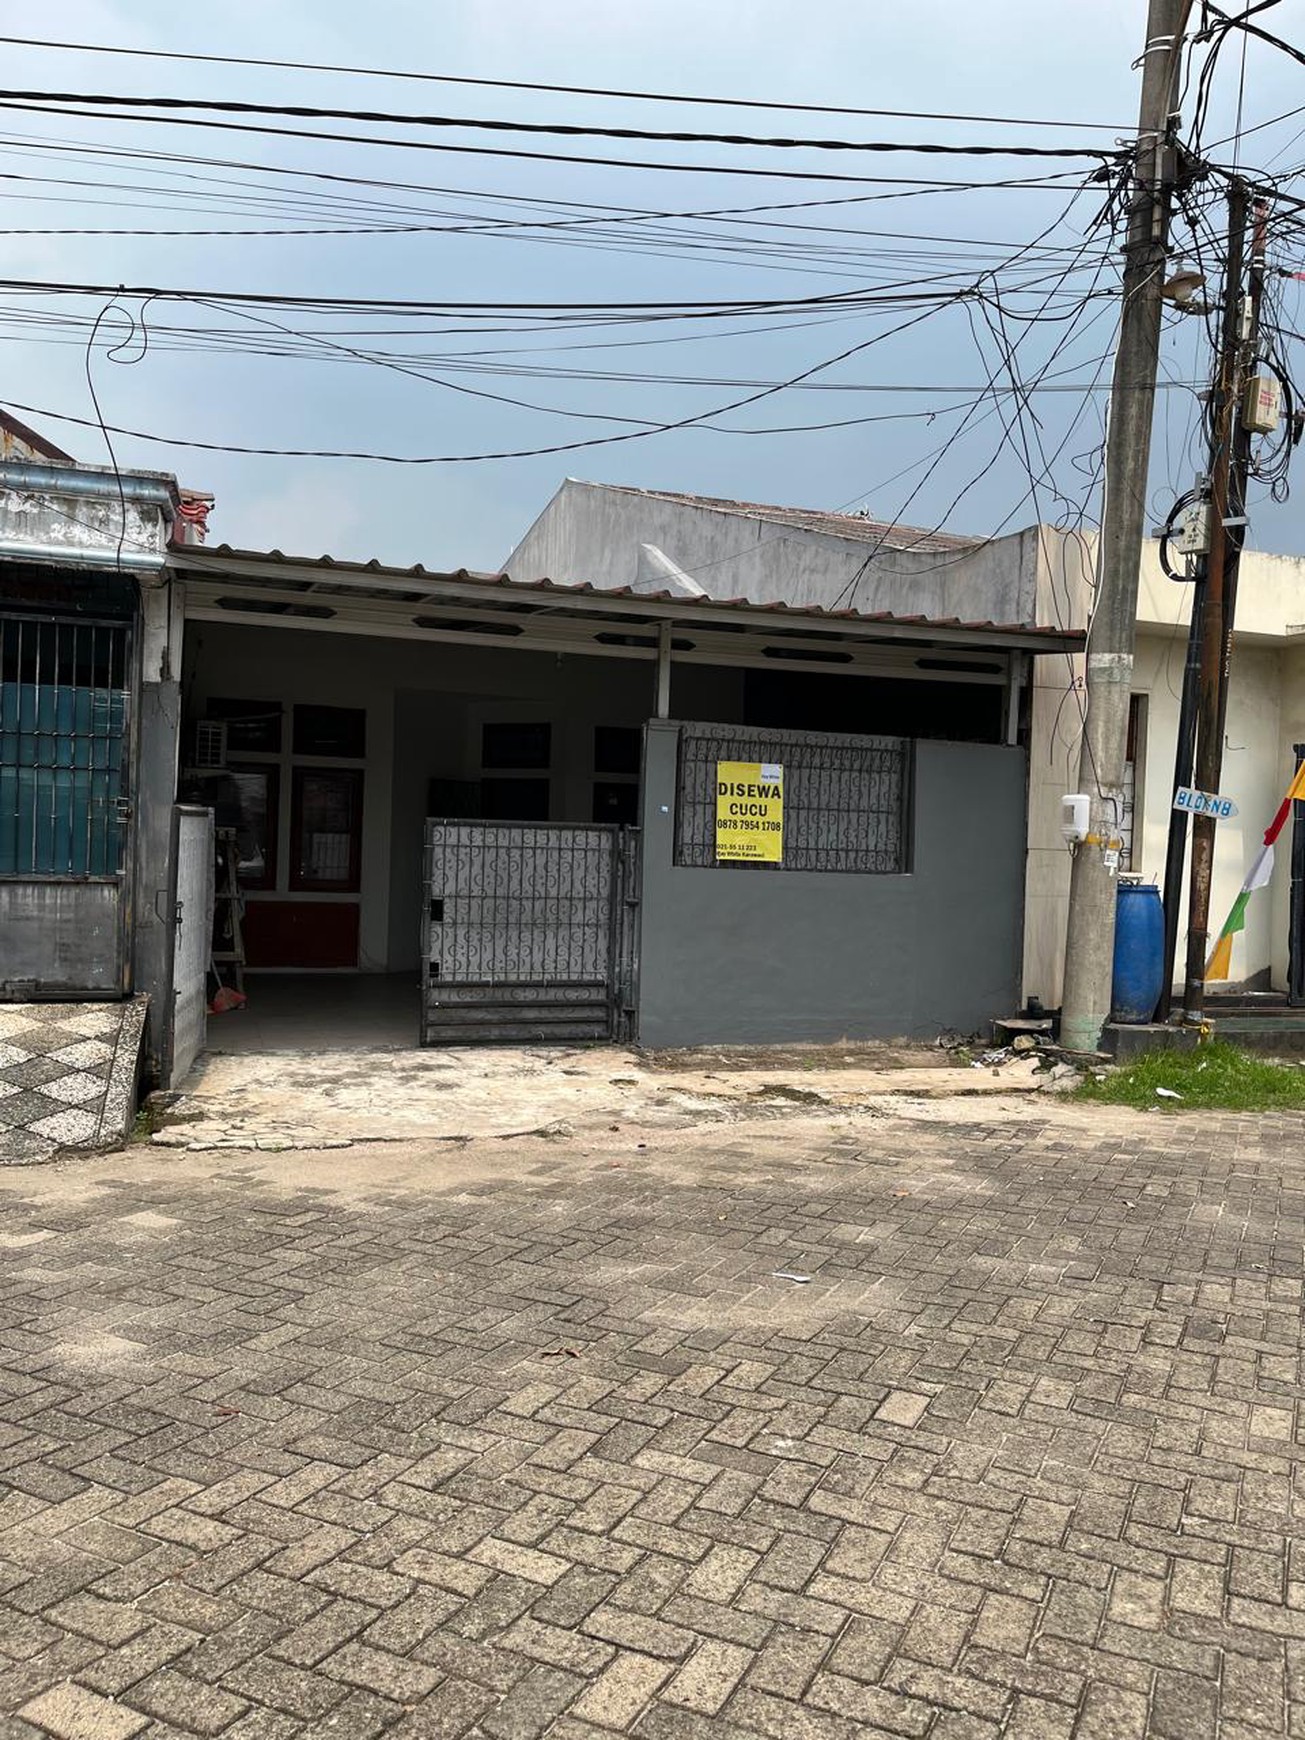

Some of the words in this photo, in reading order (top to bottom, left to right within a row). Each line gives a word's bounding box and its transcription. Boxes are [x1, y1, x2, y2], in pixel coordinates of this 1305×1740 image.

[718, 782, 781, 799] DISEWA
[729, 803, 768, 817] CUCU
[717, 819, 738, 830] 0878
[739, 820, 760, 831] 7954
[761, 821, 781, 832] 1708
